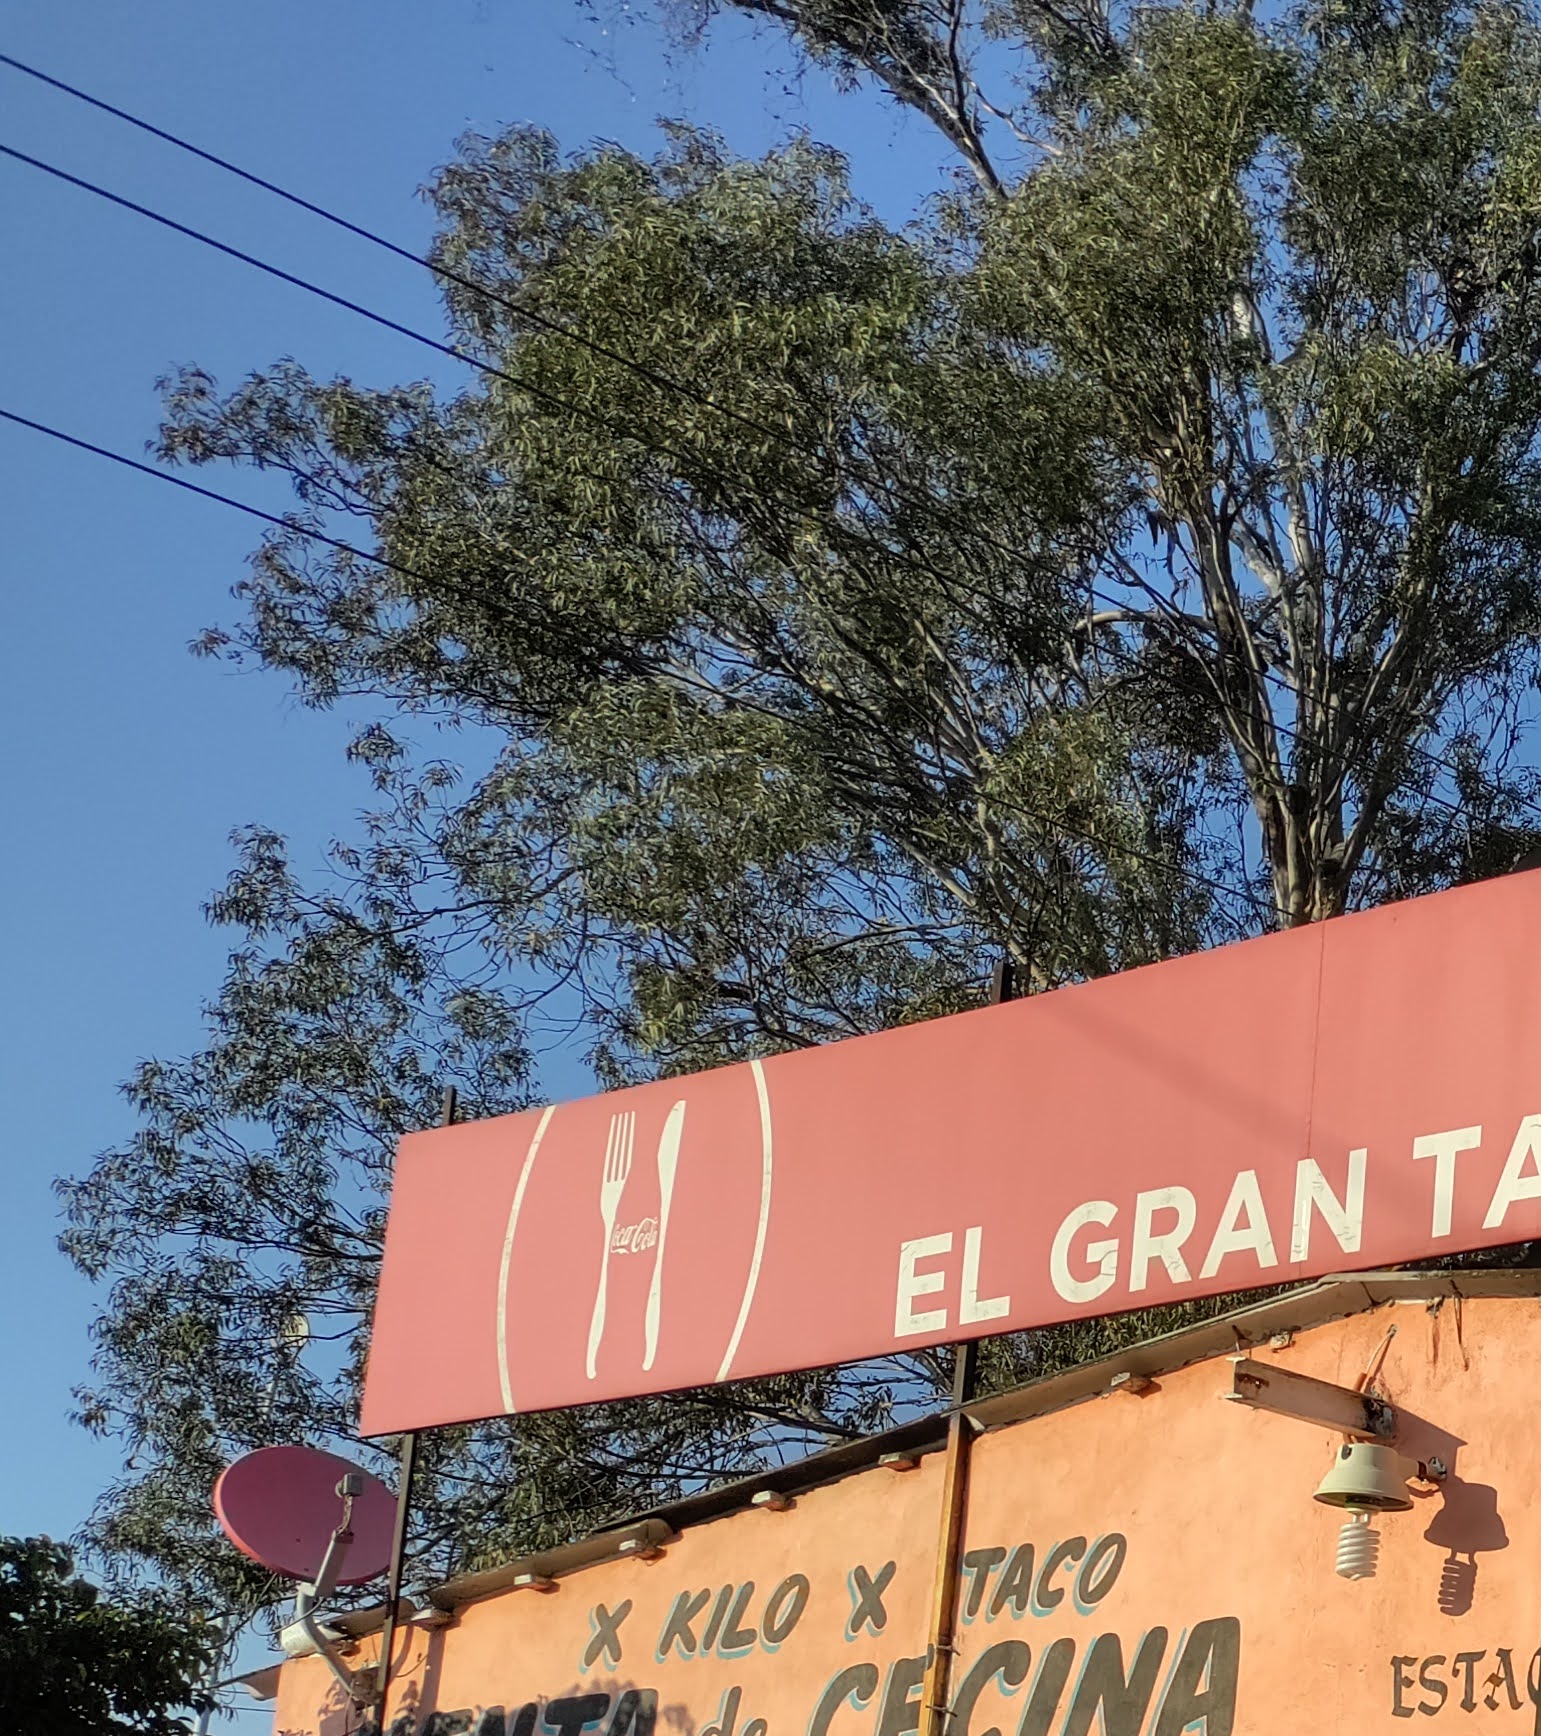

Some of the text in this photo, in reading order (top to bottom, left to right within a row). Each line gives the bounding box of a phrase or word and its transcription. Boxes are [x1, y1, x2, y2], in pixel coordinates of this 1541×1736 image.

[894, 1226, 1011, 1338] EL
[1050, 1147, 1368, 1304] GRAN
[581, 1531, 1128, 1672] X KILO X TACO
